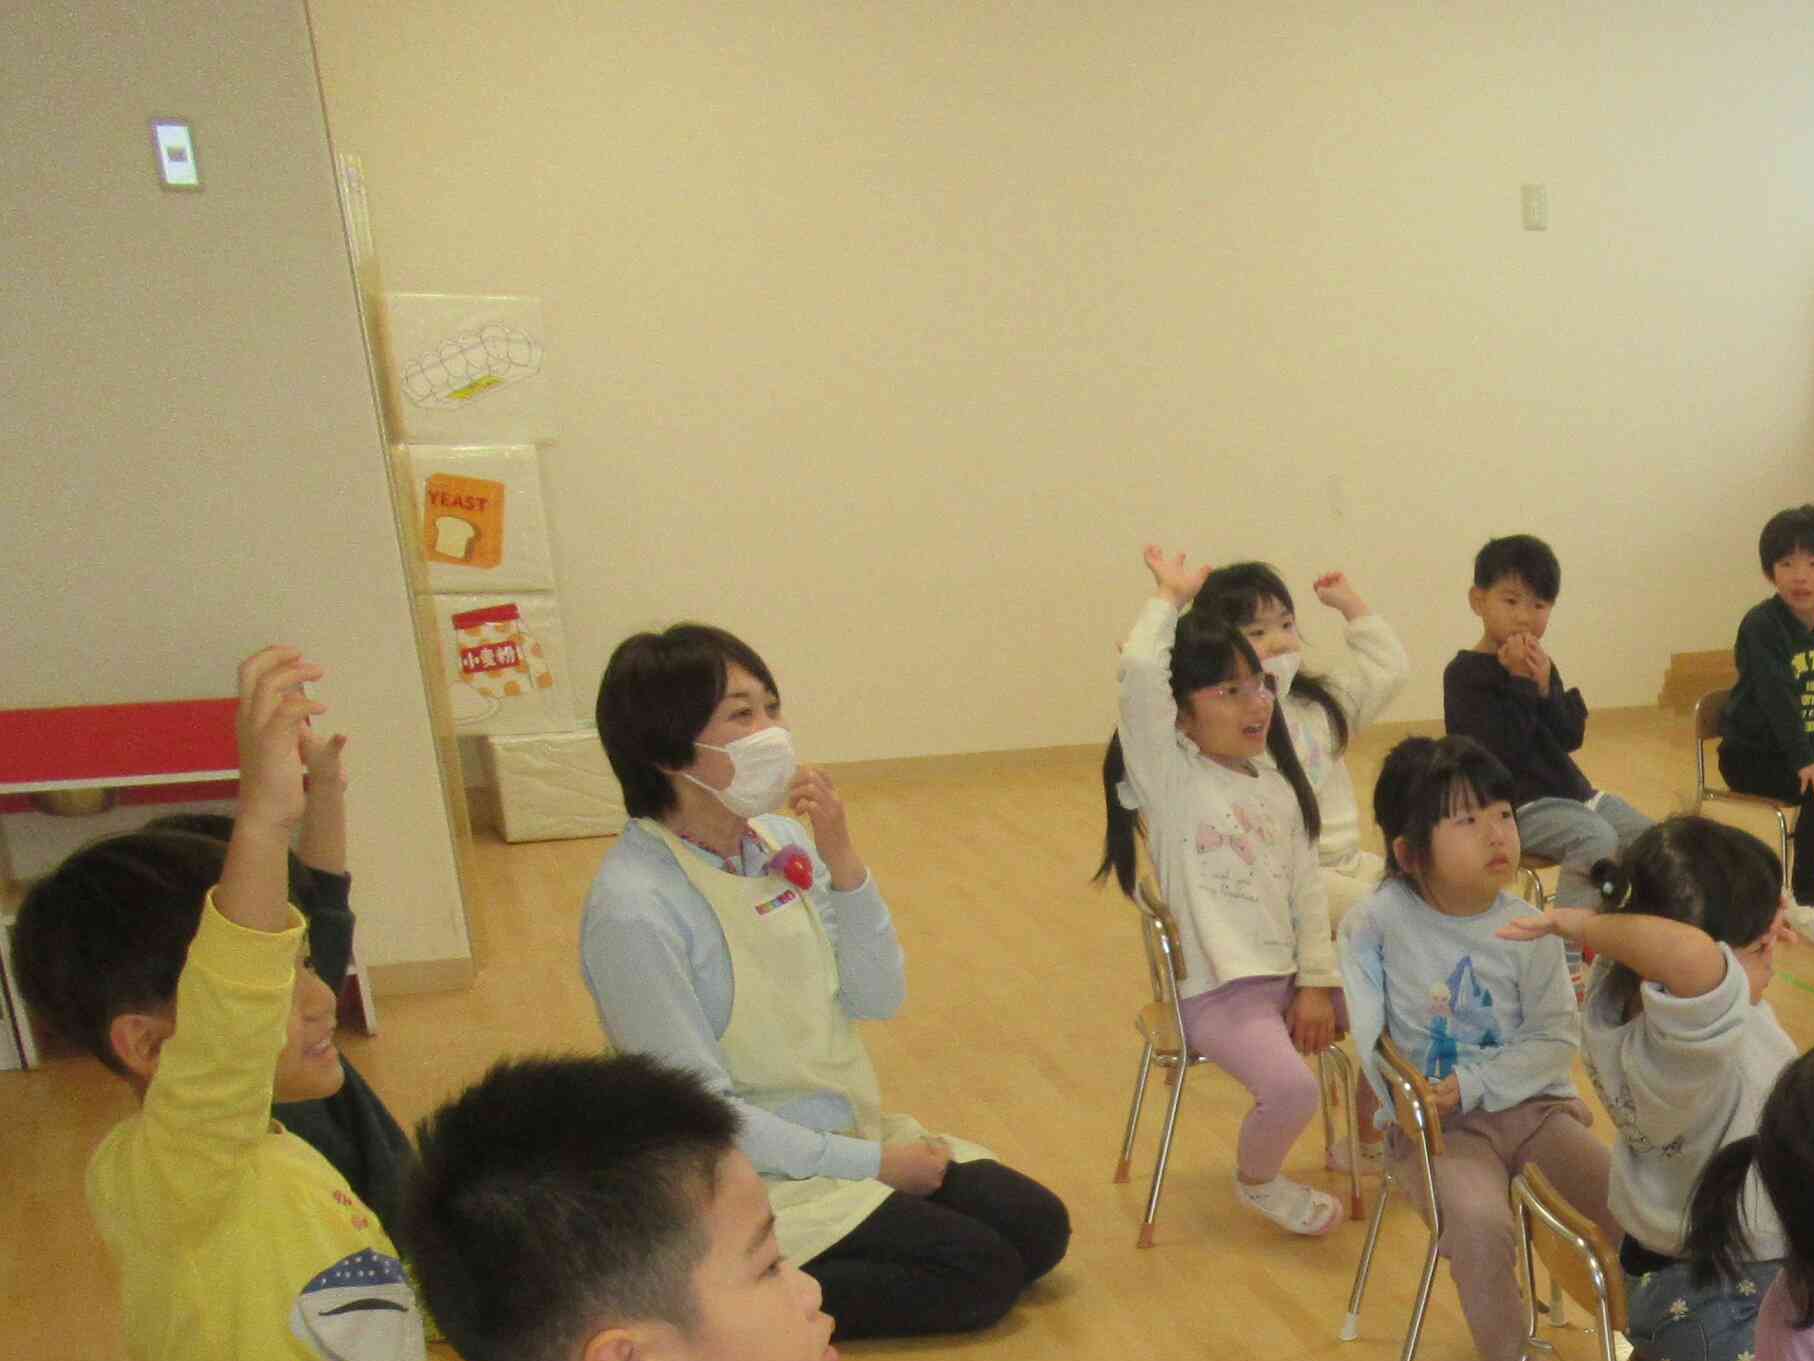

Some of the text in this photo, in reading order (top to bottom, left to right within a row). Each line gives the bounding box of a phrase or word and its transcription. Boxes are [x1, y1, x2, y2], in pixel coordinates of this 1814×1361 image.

[428, 488, 489, 511] YEAST
[463, 646, 515, 669] 小麦粉
